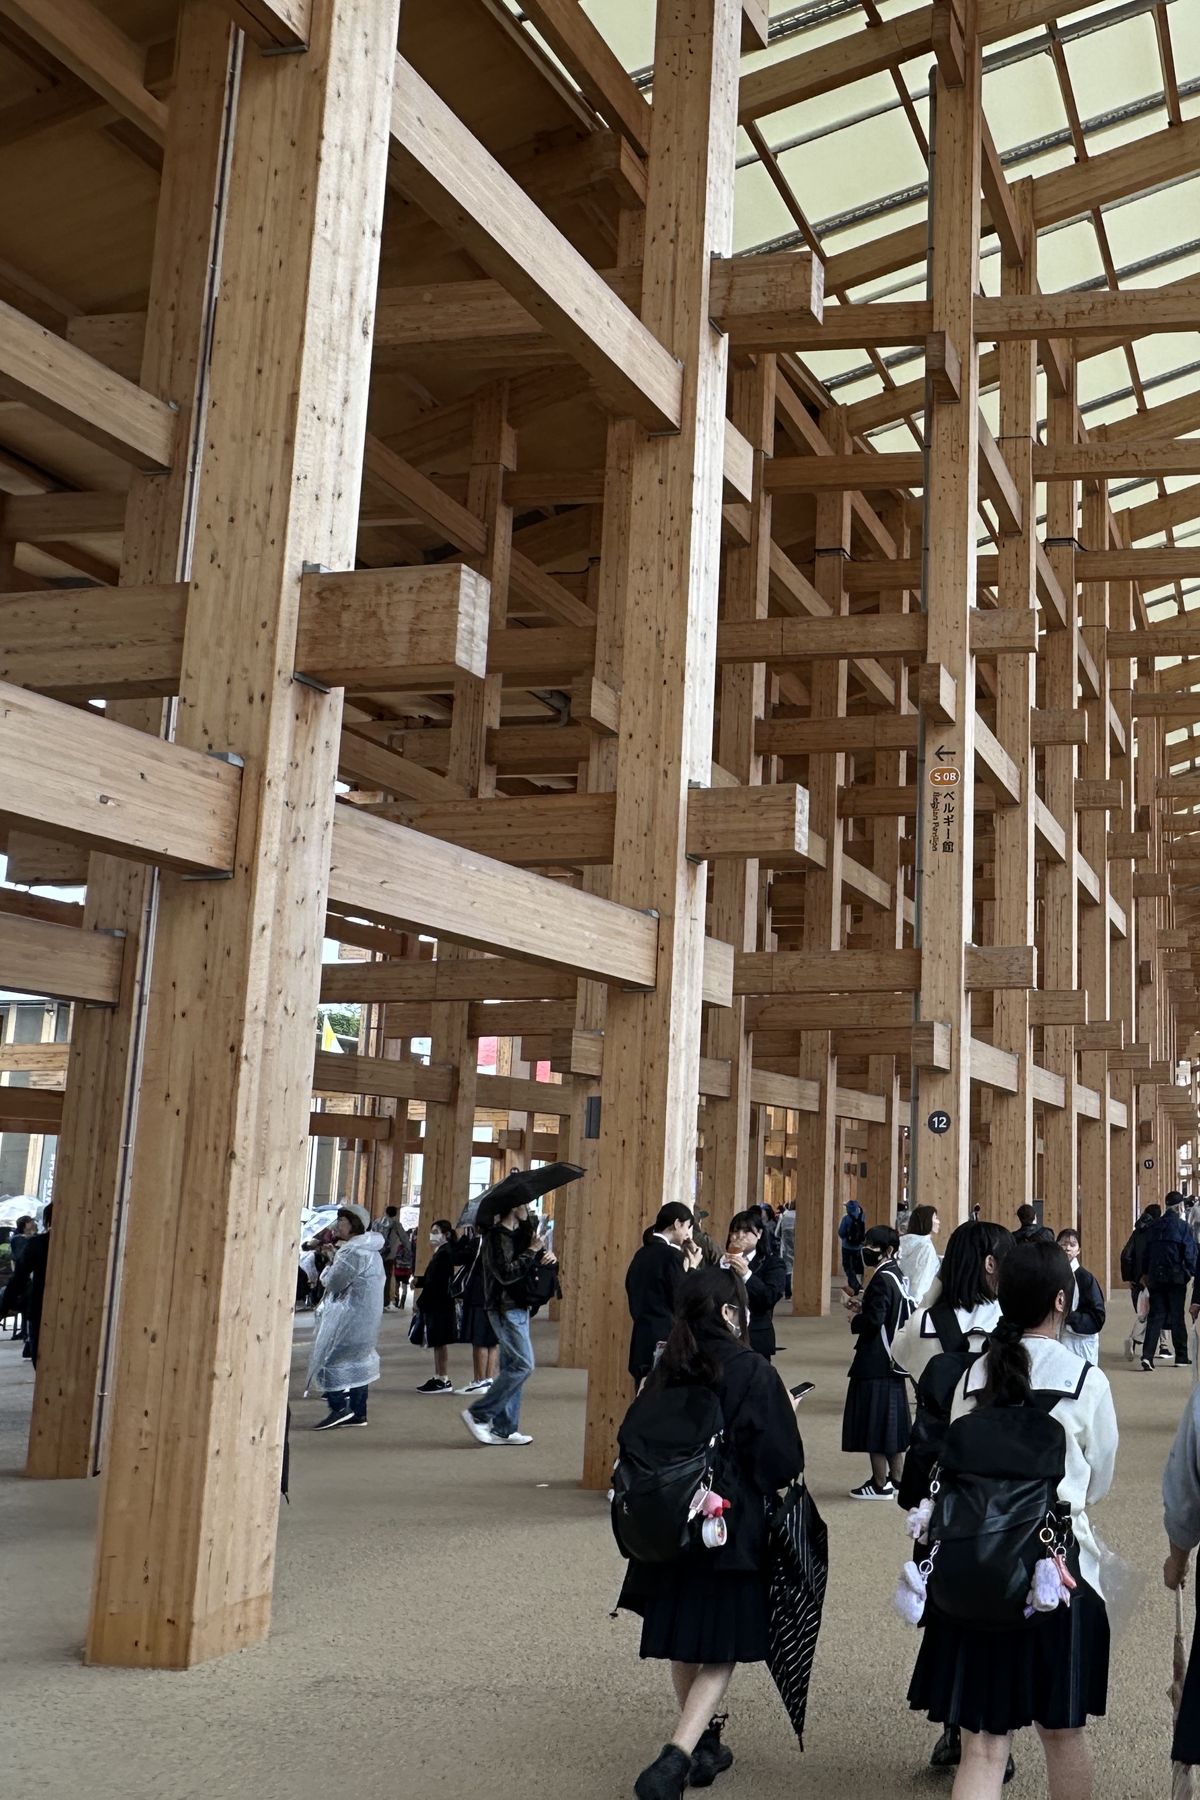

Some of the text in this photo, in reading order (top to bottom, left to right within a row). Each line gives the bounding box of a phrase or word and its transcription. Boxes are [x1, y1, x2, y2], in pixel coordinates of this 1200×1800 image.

[934, 772, 941, 781] S
[942, 790, 955, 853] ベルギー館
[932, 1116, 947, 1128] 12
